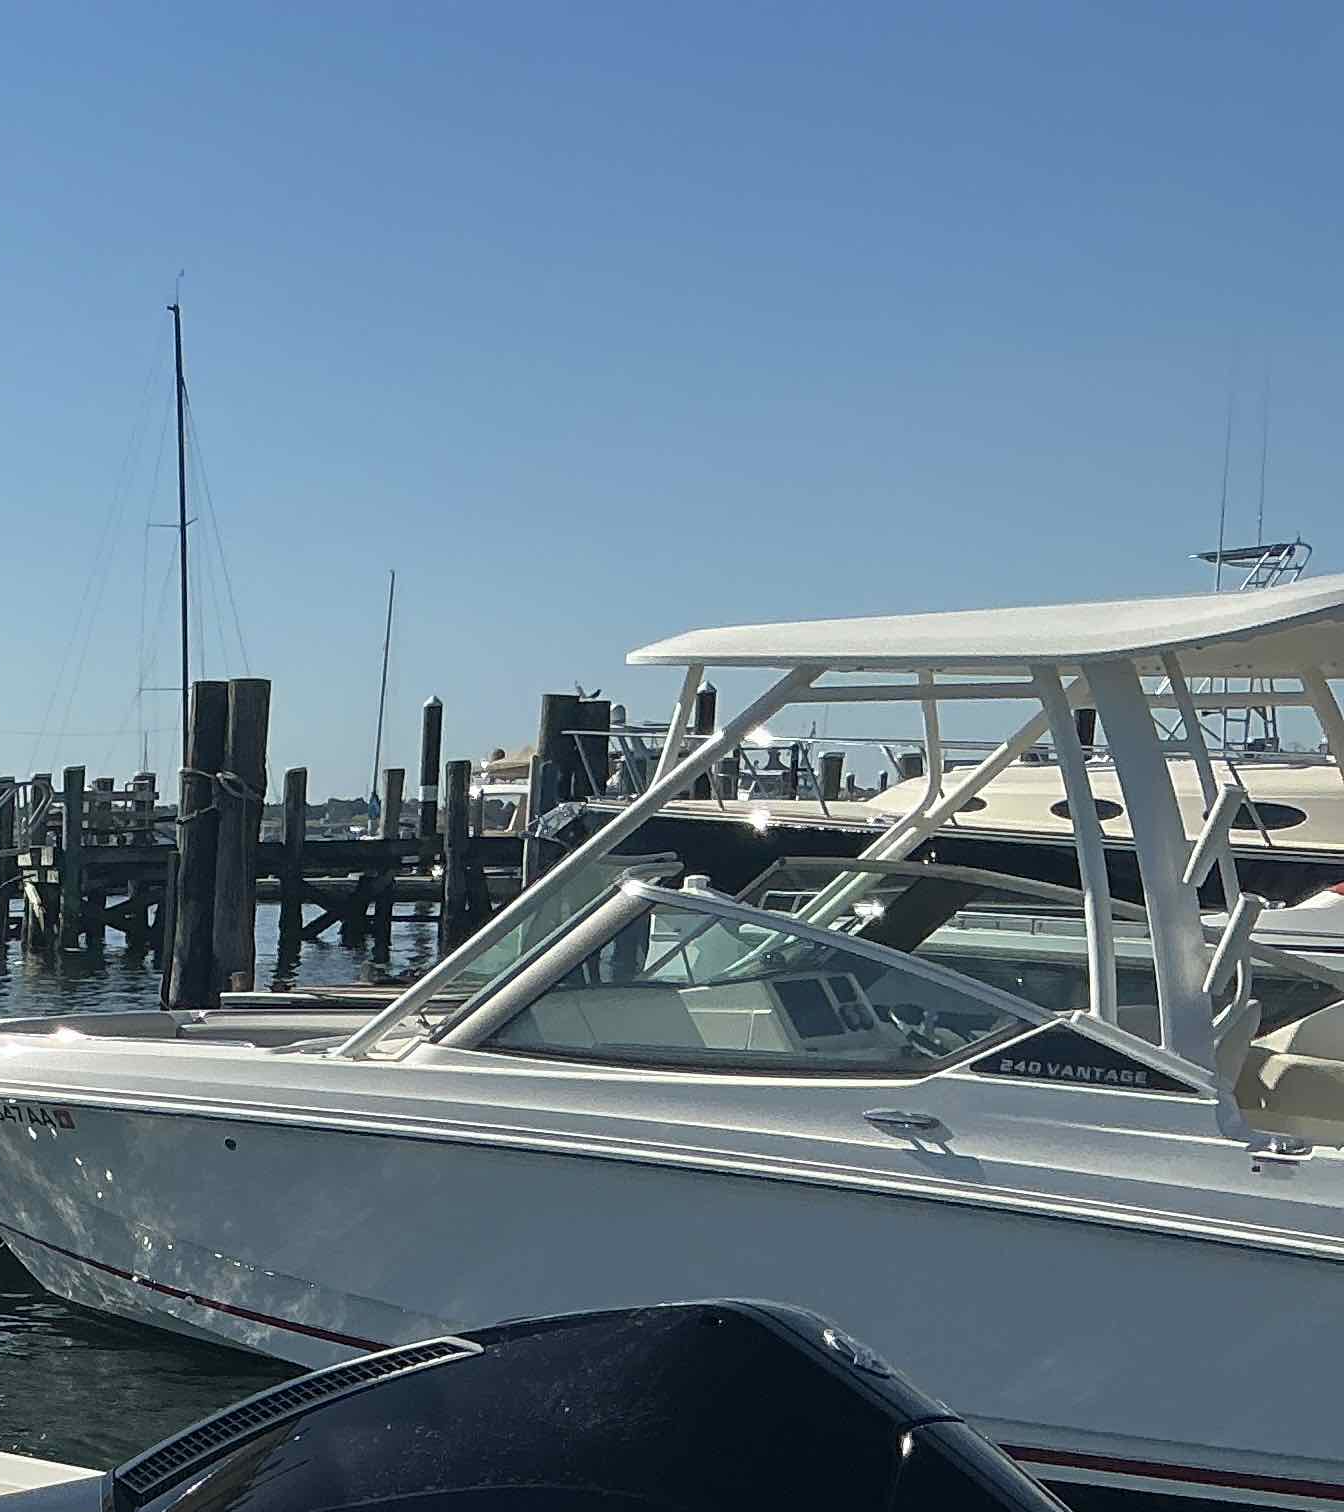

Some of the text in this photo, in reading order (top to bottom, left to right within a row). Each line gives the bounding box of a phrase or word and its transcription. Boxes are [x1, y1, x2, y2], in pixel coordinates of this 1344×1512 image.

[999, 1059, 1148, 1084] 240 VANTAGE
[26, 1107, 57, 1129] AA
